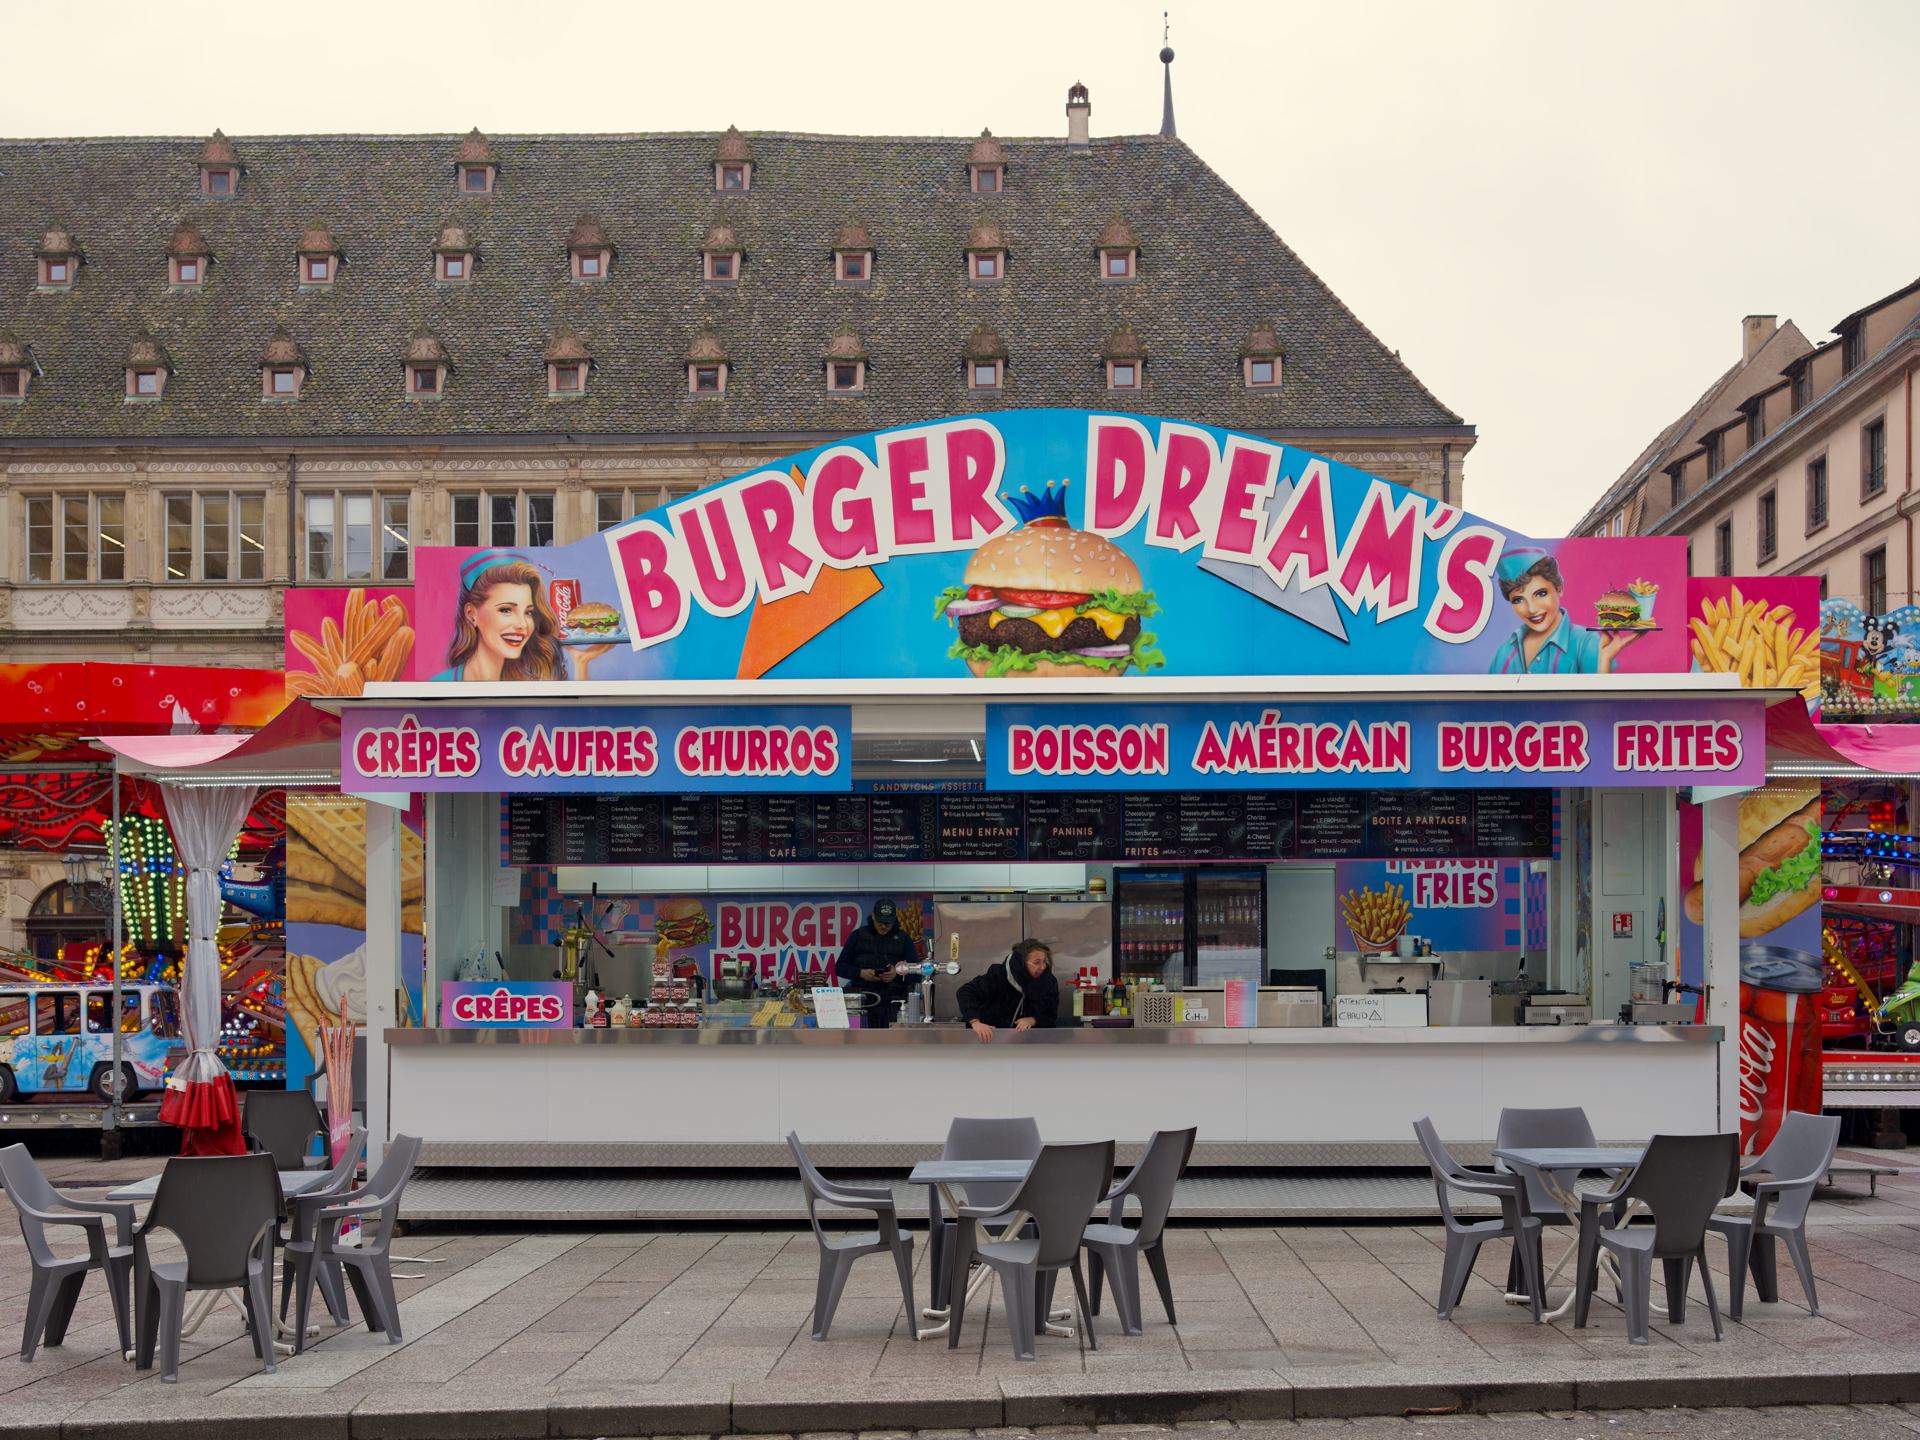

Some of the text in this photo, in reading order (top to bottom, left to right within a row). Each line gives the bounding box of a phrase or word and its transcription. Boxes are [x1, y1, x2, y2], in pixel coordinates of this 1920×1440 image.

[606, 417, 1504, 648] BURGER DREAM'S
[353, 714, 839, 778] CRÊPES GAUFRES CHURROS
[1009, 709, 1743, 776] BOISSON AMÉRICAIN BURGER FRITES
[941, 782, 984, 791] ASSIETTE
[1372, 815, 1467, 825] BOITE A PARTAGER
[942, 827, 1020, 837] MENU ENFANT
[1052, 827, 1093, 836] PANINIS
[769, 846, 797, 857] CAFÉ
[1125, 847, 1159, 856] FRITES
[1414, 871, 1497, 908] FRIES
[717, 902, 862, 949] BURGER
[453, 988, 563, 1022] CRÊPES
